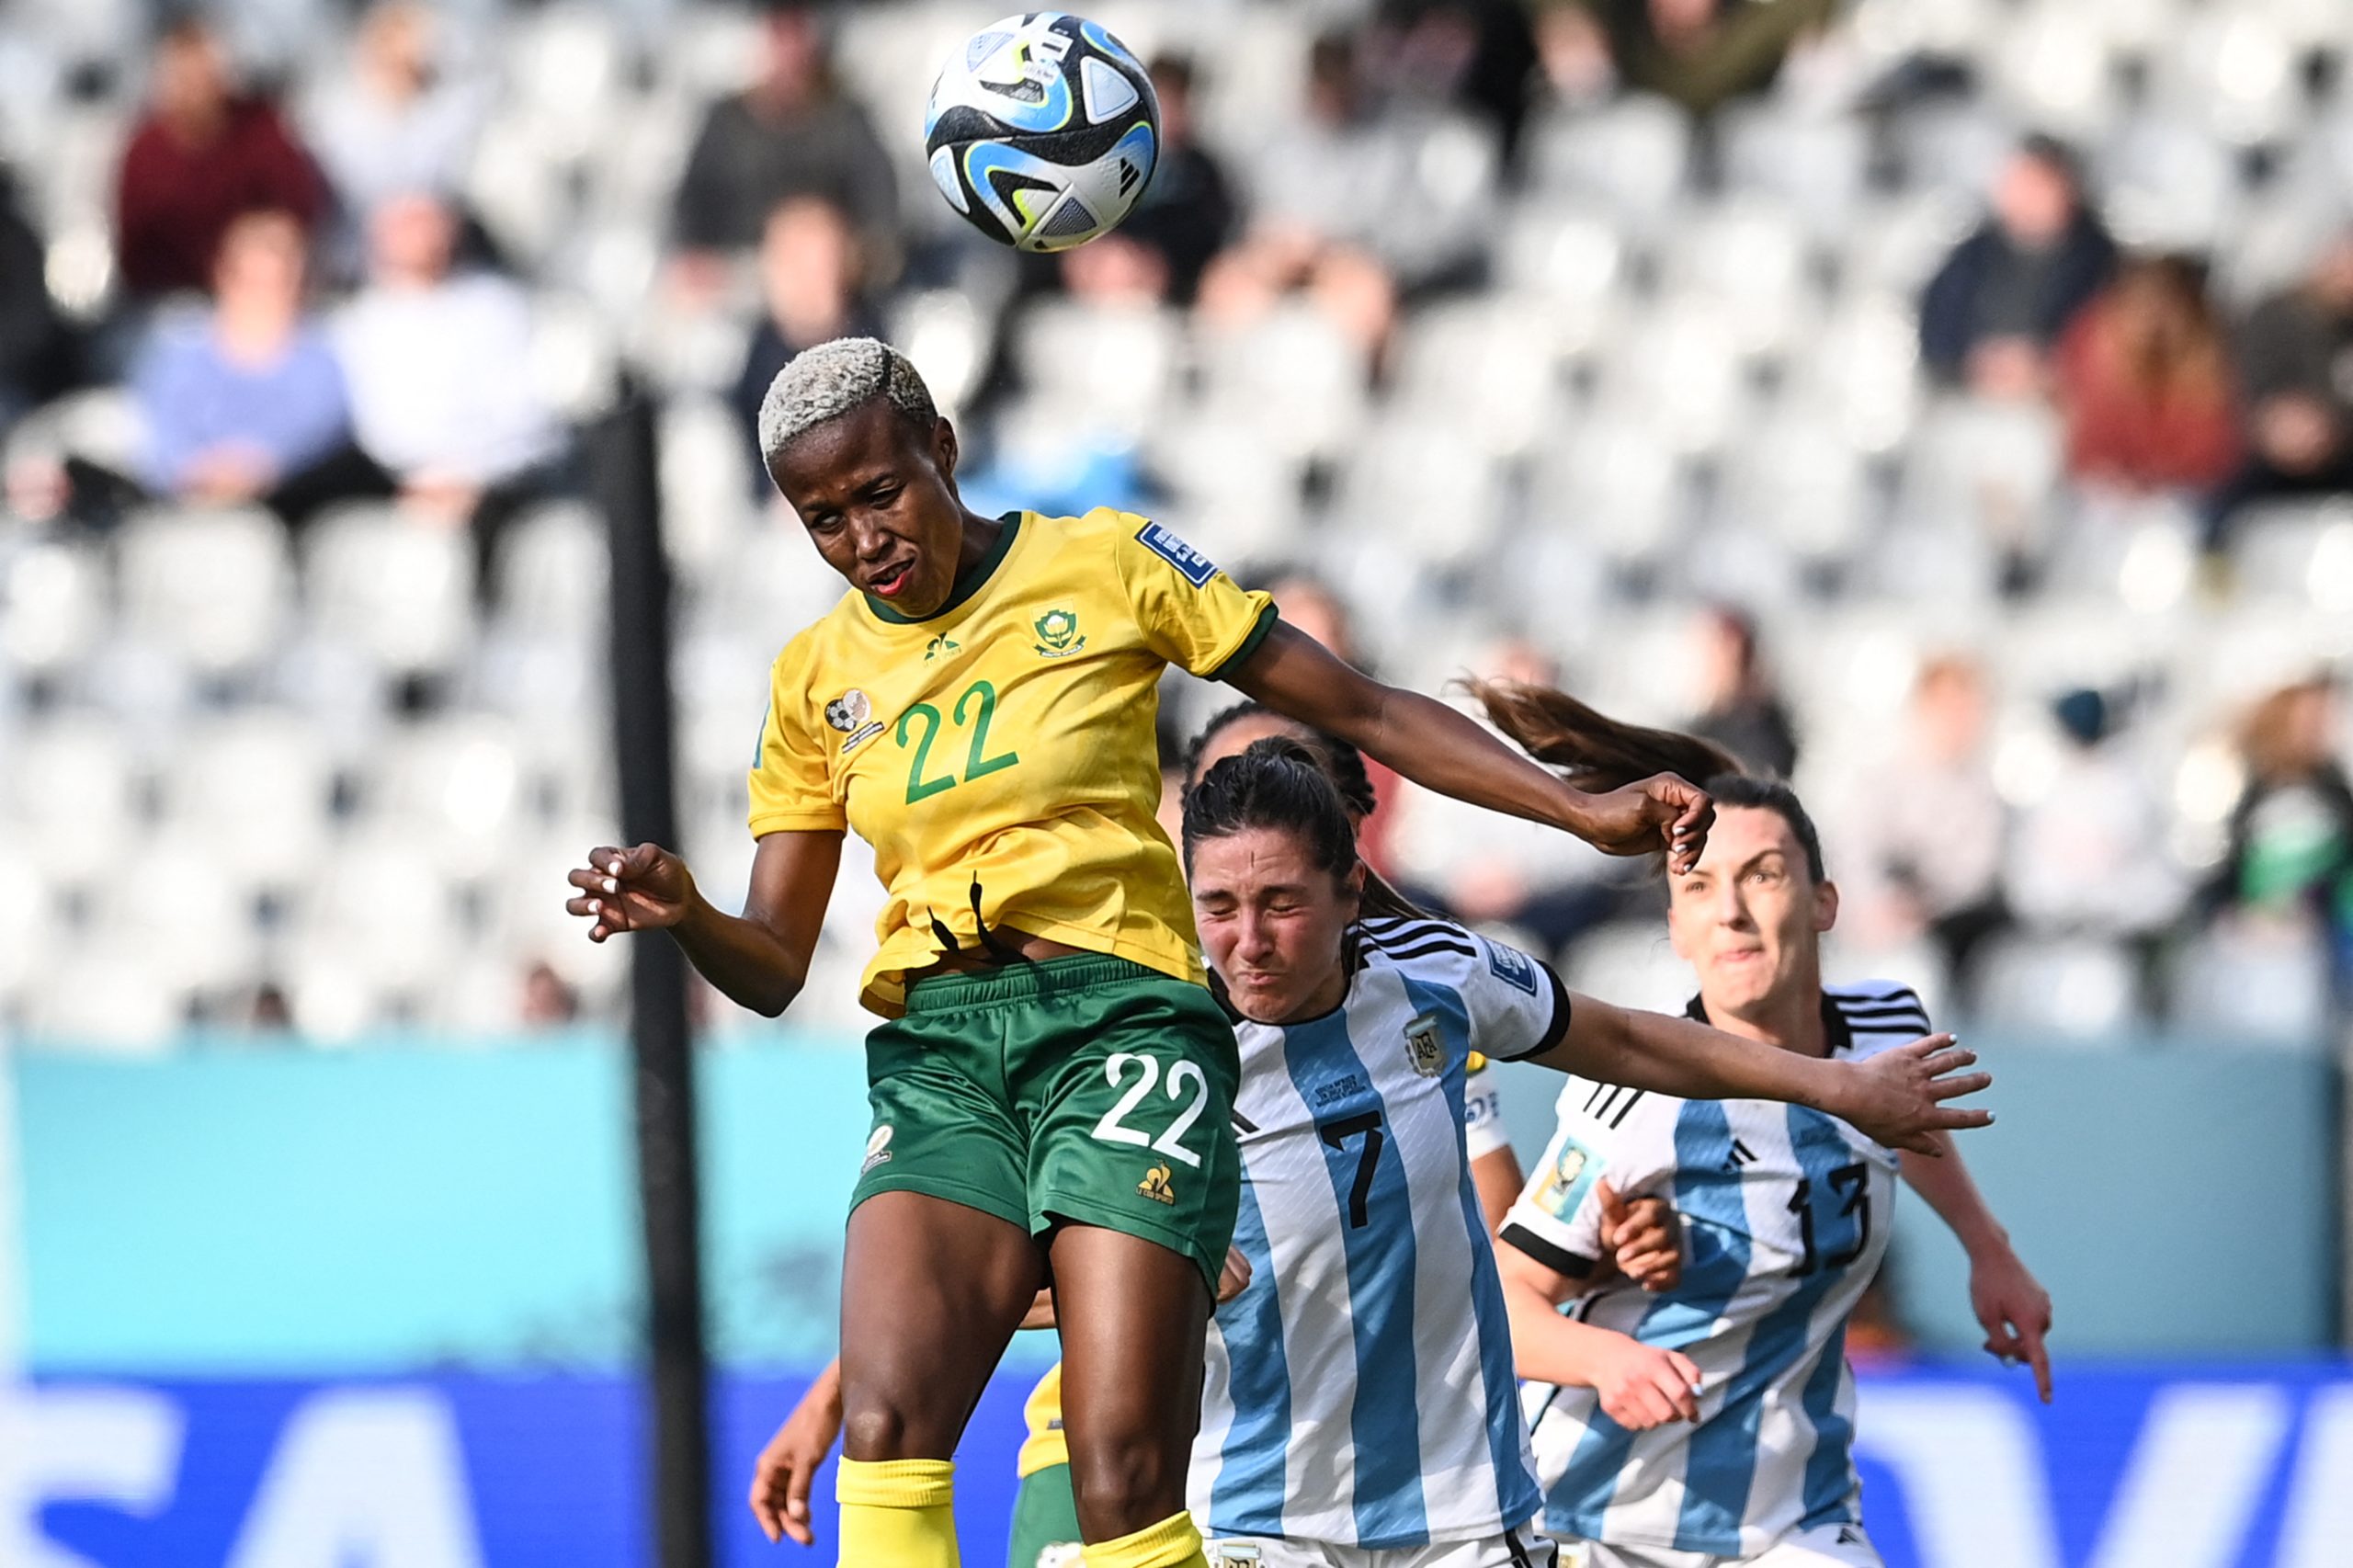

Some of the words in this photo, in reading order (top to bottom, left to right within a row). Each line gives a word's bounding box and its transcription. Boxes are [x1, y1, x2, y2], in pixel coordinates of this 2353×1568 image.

[895, 679, 1019, 806] 22
[1090, 1051, 1209, 1169] 22
[1319, 1109, 1383, 1230] 7
[1786, 1161, 1872, 1279] 13
